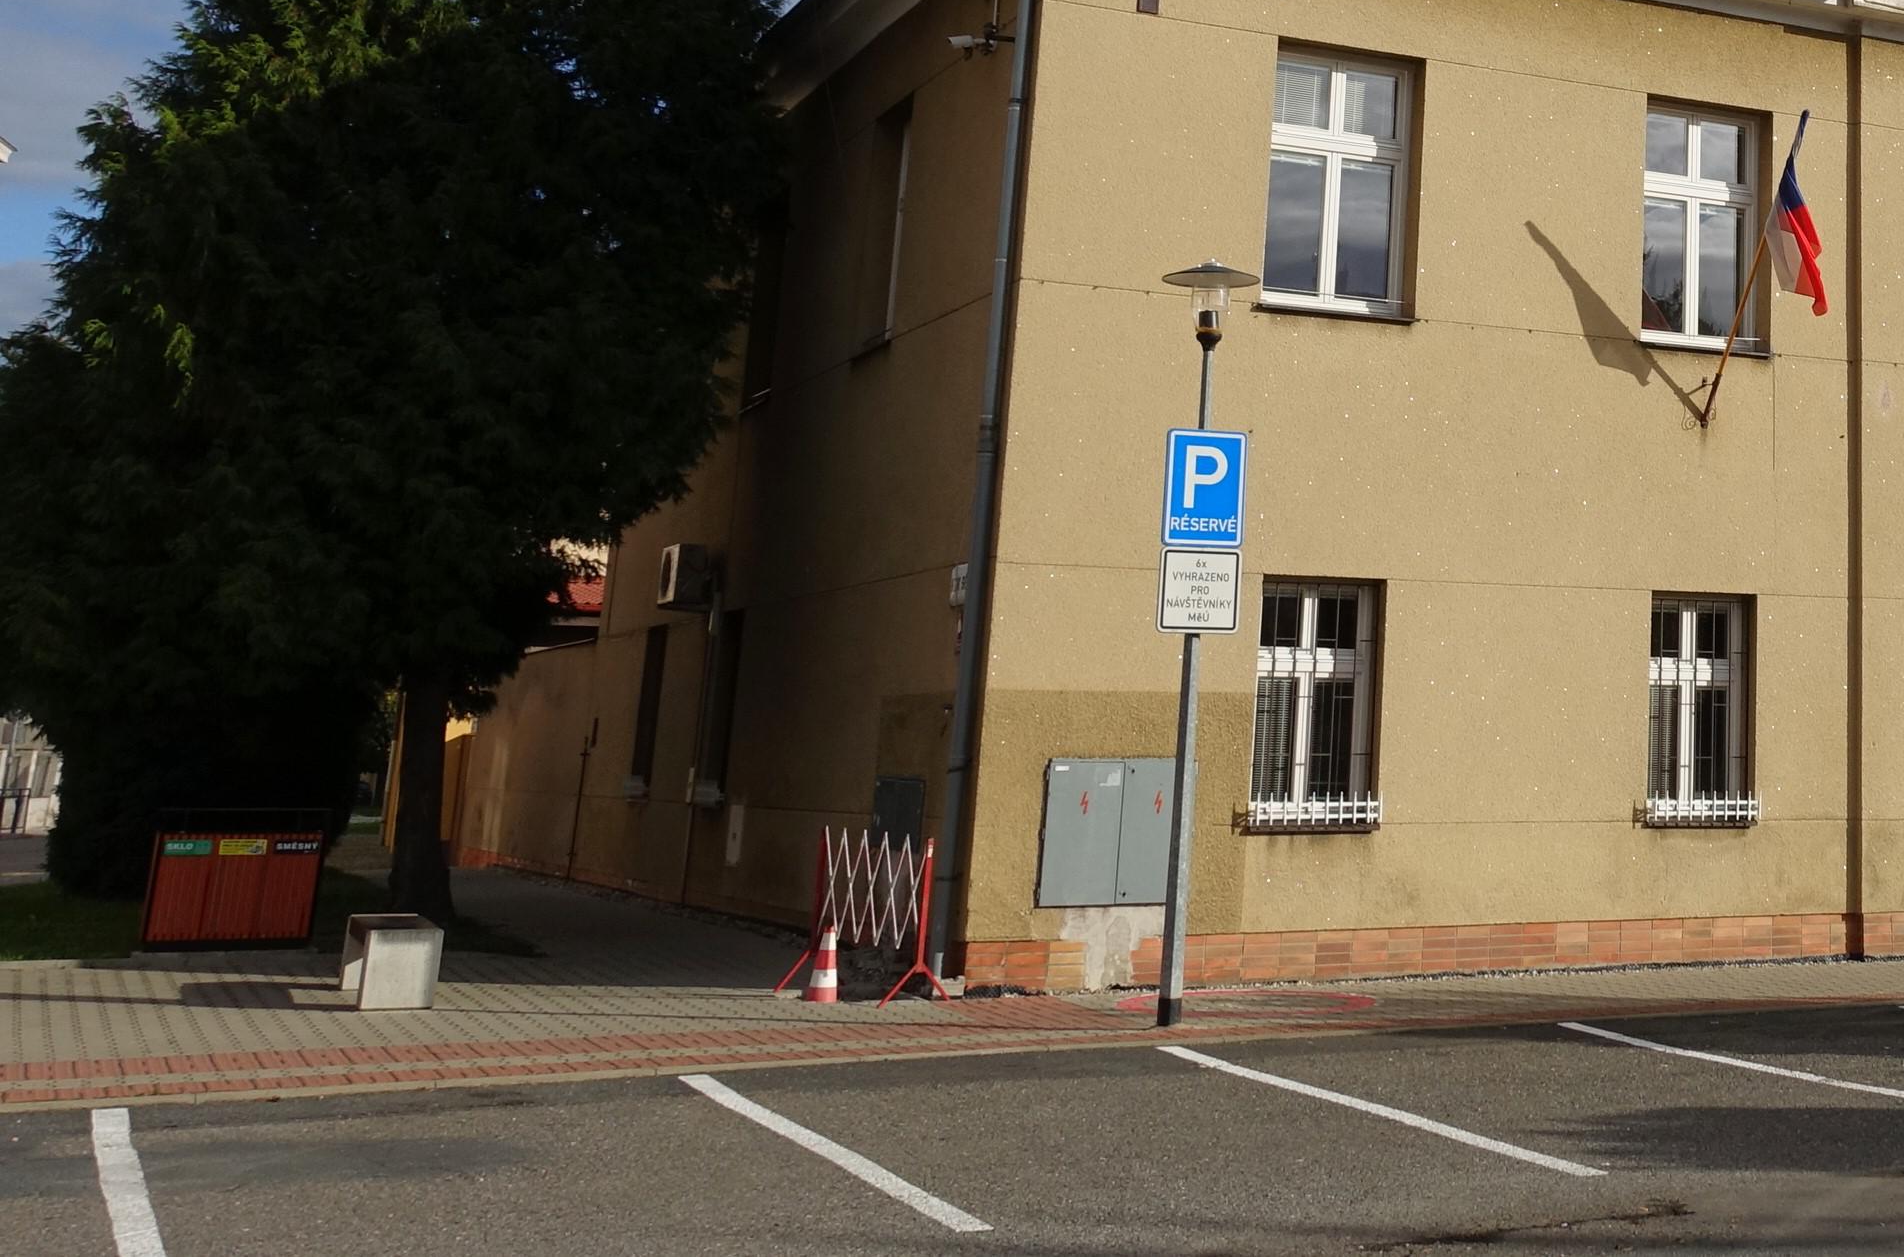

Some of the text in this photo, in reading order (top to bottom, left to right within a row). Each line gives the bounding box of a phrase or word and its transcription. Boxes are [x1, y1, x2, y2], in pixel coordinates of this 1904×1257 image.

[1183, 445, 1228, 509] P
[1170, 513, 1237, 533] RÉSERVÉ
[1195, 559, 1207, 568] 6x
[1172, 571, 1230, 582] VYHRAZENO
[1190, 585, 1210, 595] PRO
[166, 843, 194, 851] SKLO
